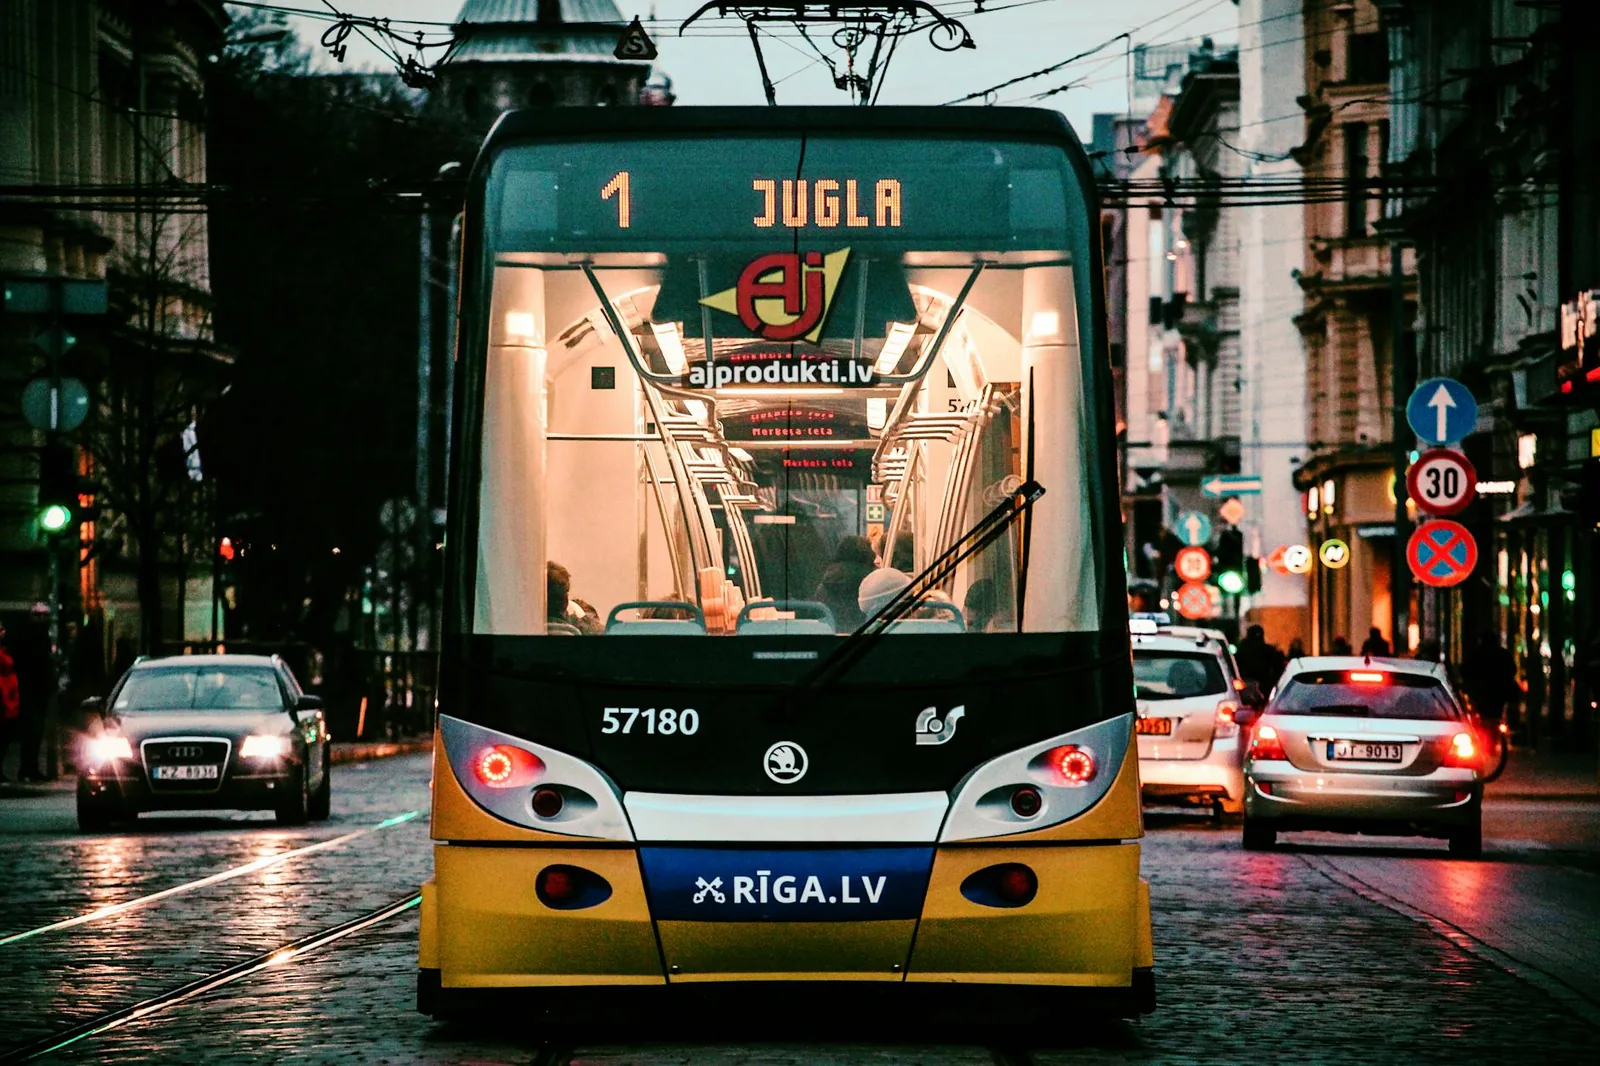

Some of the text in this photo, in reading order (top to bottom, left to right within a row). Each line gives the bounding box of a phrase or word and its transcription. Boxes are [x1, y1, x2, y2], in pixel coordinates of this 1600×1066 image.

[627, 36, 643, 53] S
[601, 171, 903, 228] 1 JUGLA
[689, 360, 874, 388] ajprodukti.lv
[1426, 467, 1459, 499] 30
[601, 707, 699, 736] 57180
[732, 870, 887, 904] RĪGA.LV
